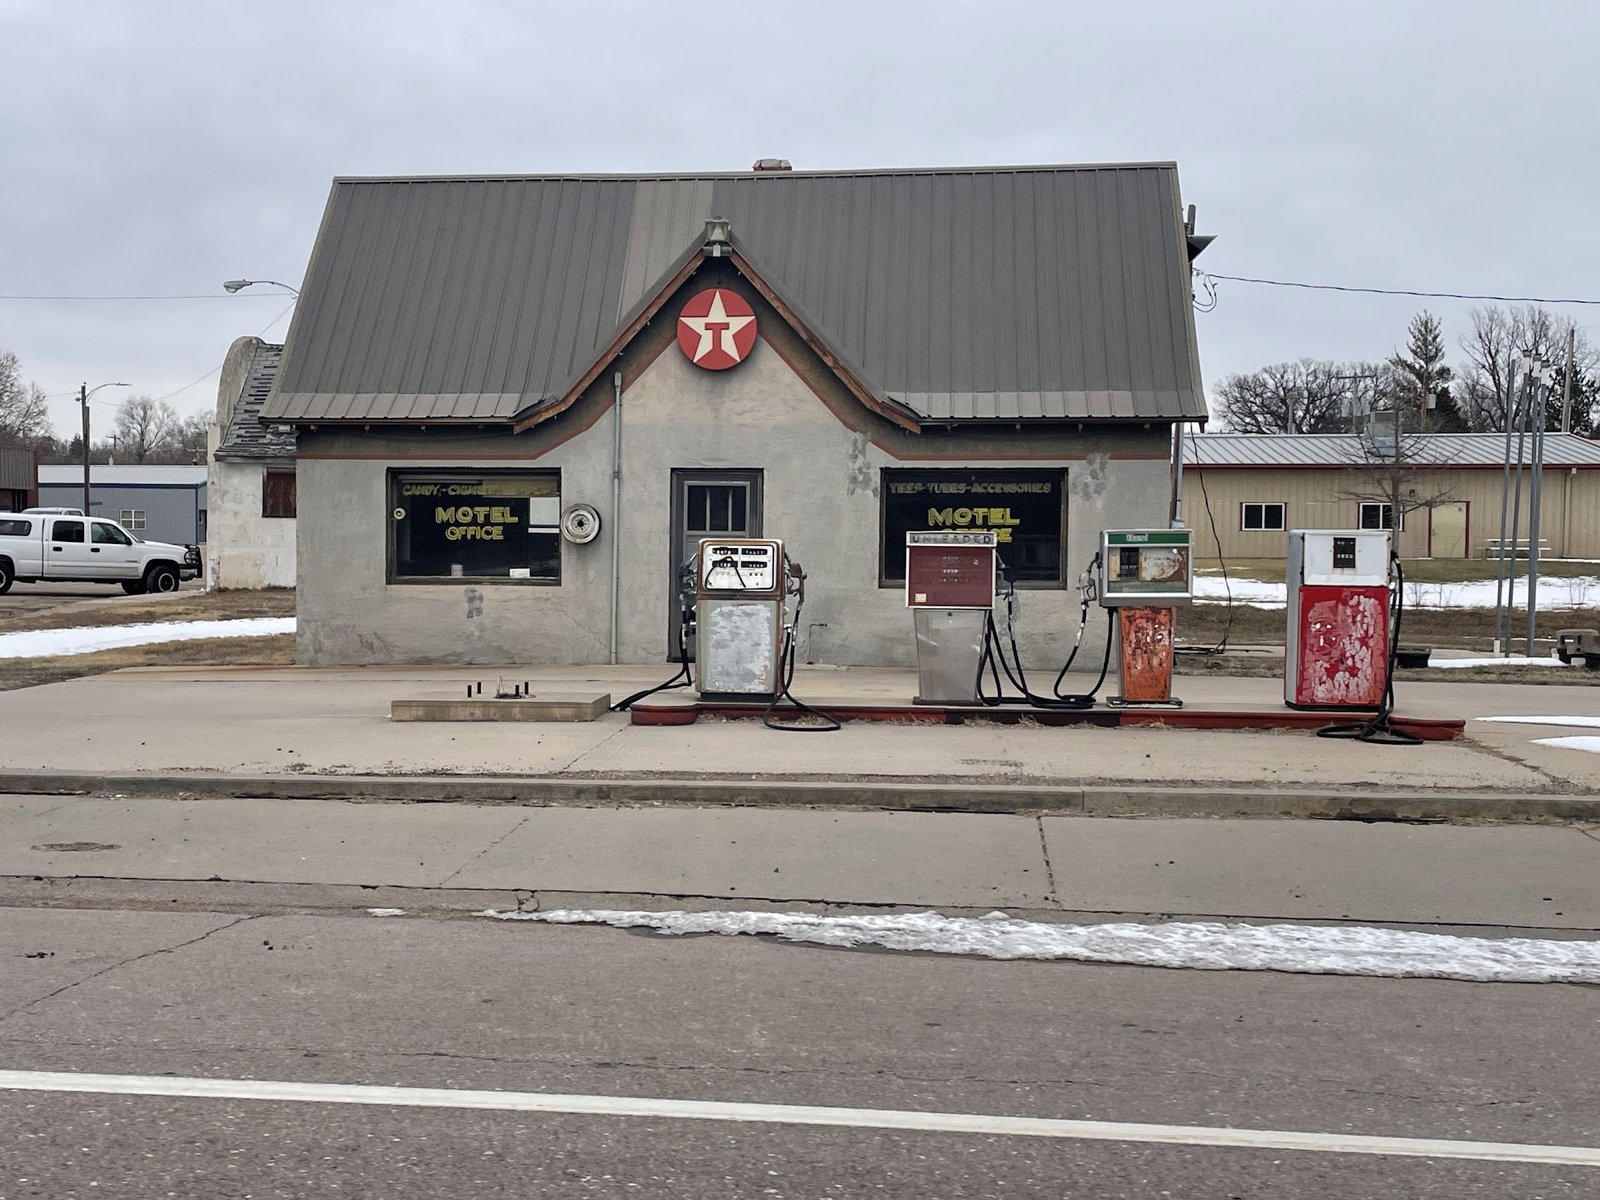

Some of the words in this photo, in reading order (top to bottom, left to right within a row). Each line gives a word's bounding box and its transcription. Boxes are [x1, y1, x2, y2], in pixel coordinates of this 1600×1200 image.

[435, 506, 518, 524] MOTEL
[927, 507, 1021, 526] MOTEL
[445, 525, 504, 541] OFFICE
[911, 534, 991, 544] UNLEADED
